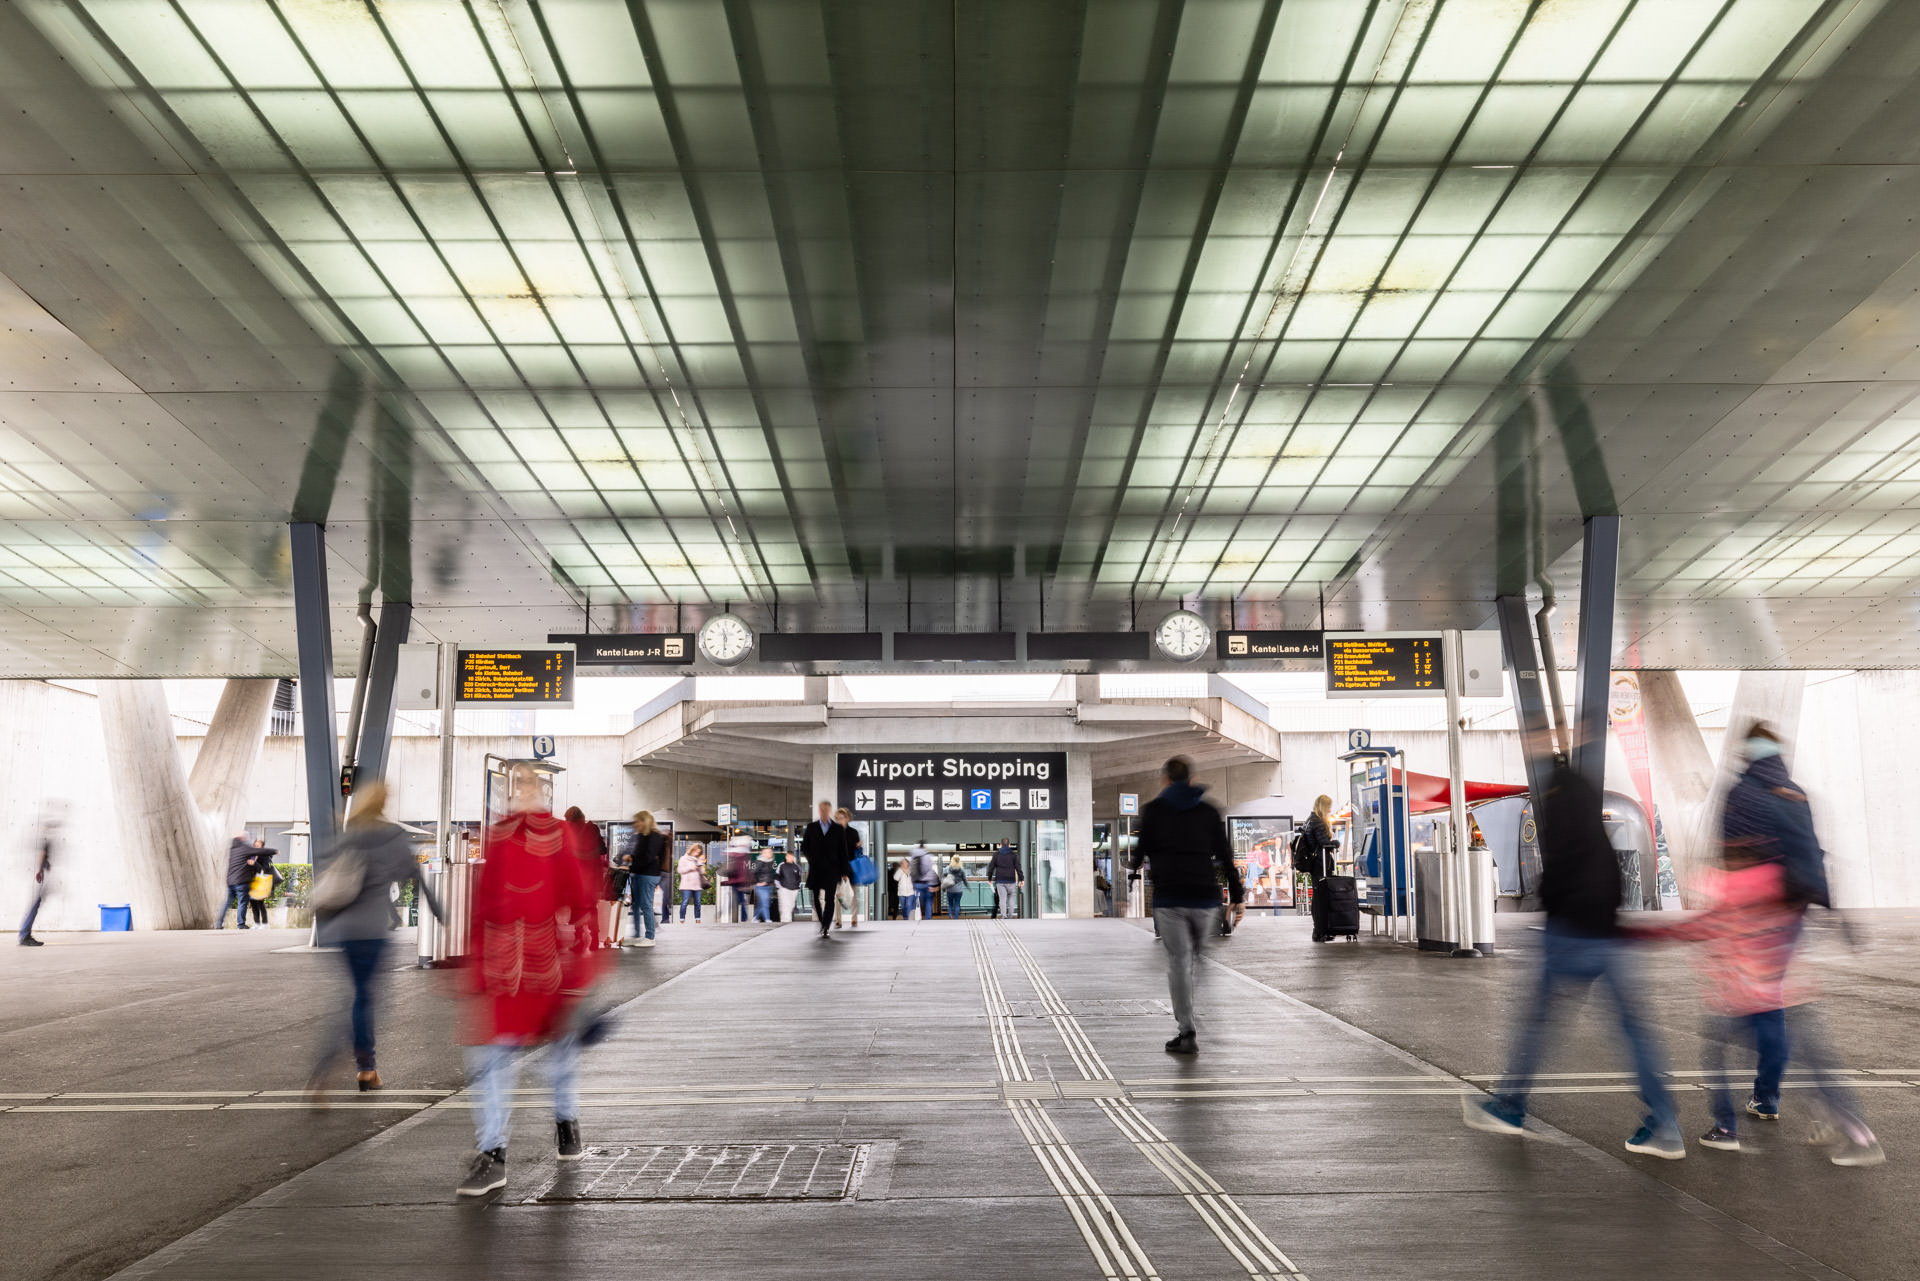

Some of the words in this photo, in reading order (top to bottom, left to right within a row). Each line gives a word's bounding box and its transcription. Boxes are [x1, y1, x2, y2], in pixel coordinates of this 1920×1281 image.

[647, 648, 660, 656] J-R
[856, 759, 934, 780] Airport
[942, 758, 1050, 780] Shopping
